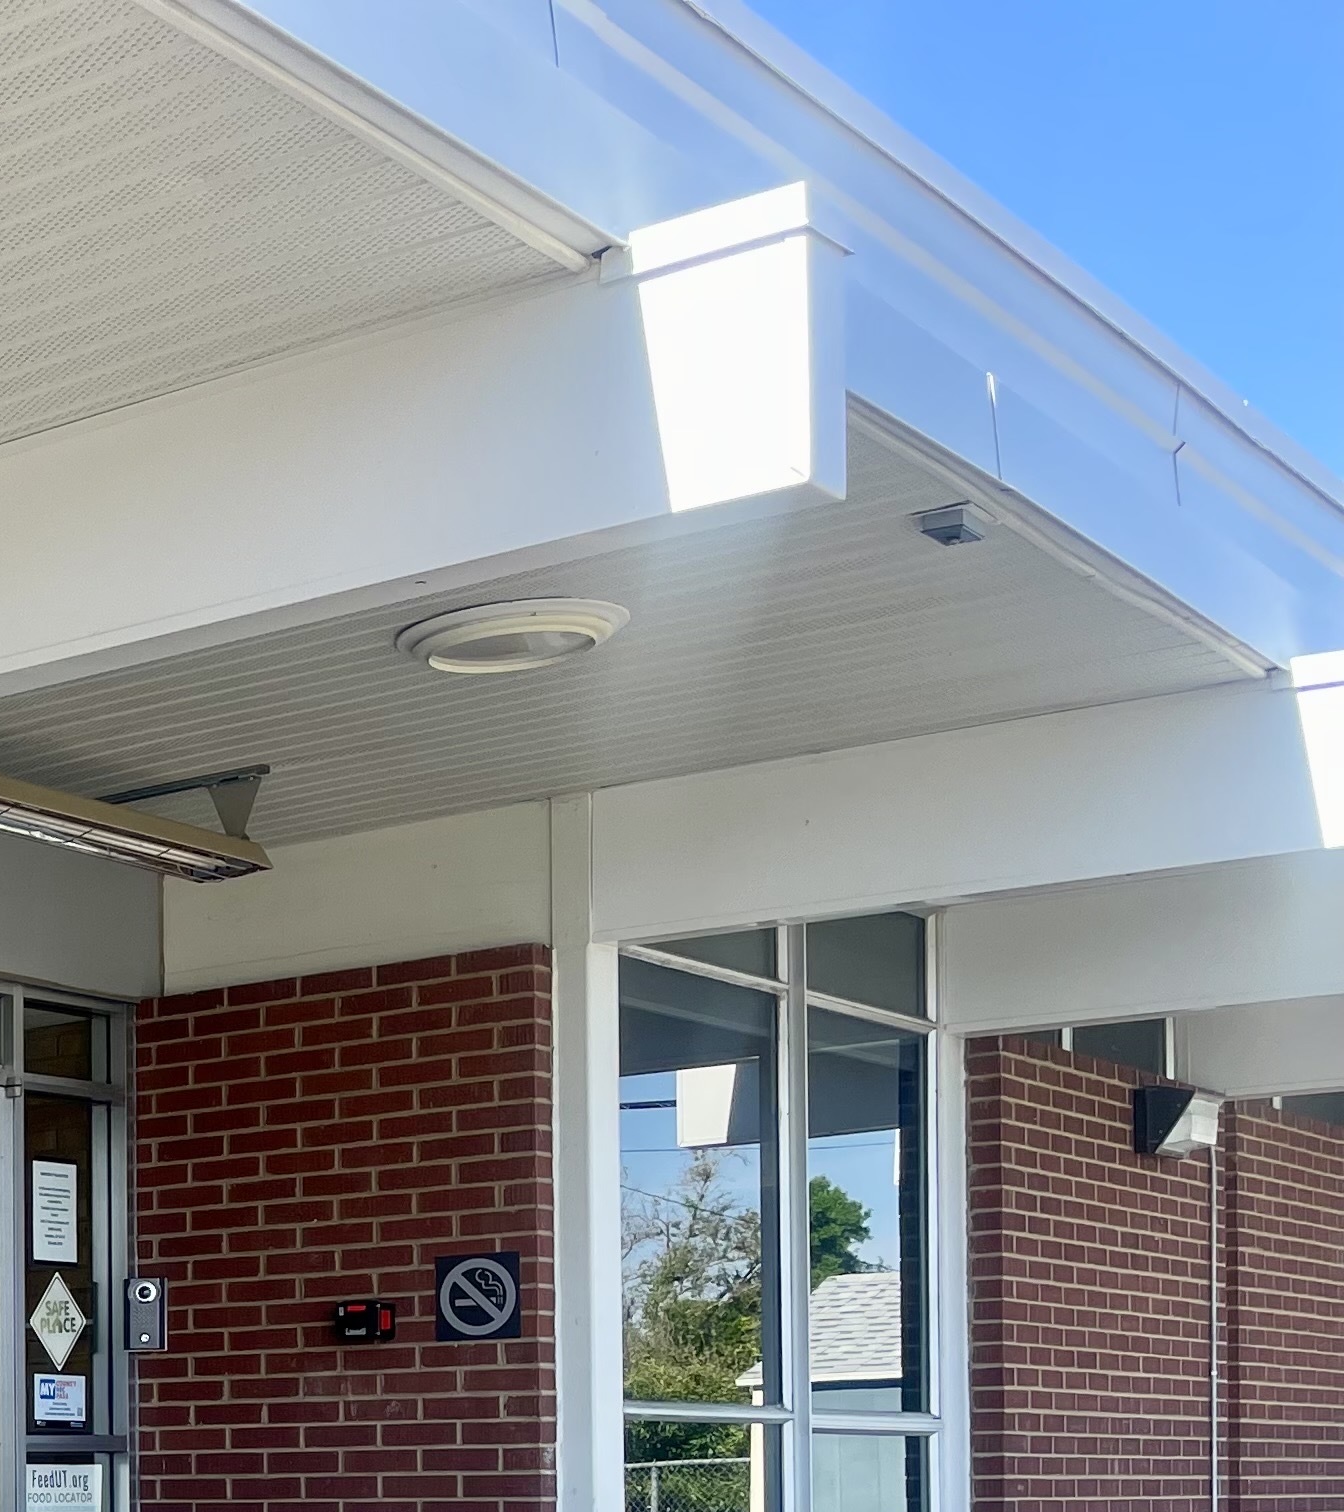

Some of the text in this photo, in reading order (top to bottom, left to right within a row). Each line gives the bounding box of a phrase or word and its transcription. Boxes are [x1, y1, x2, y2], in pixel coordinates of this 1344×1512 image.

[45, 1300, 70, 1316] SAFE
[40, 1382, 55, 1397] MY
[32, 1470, 89, 1491] FeedUT.org
[27, 1492, 92, 1503] FOOD LOCATOR
